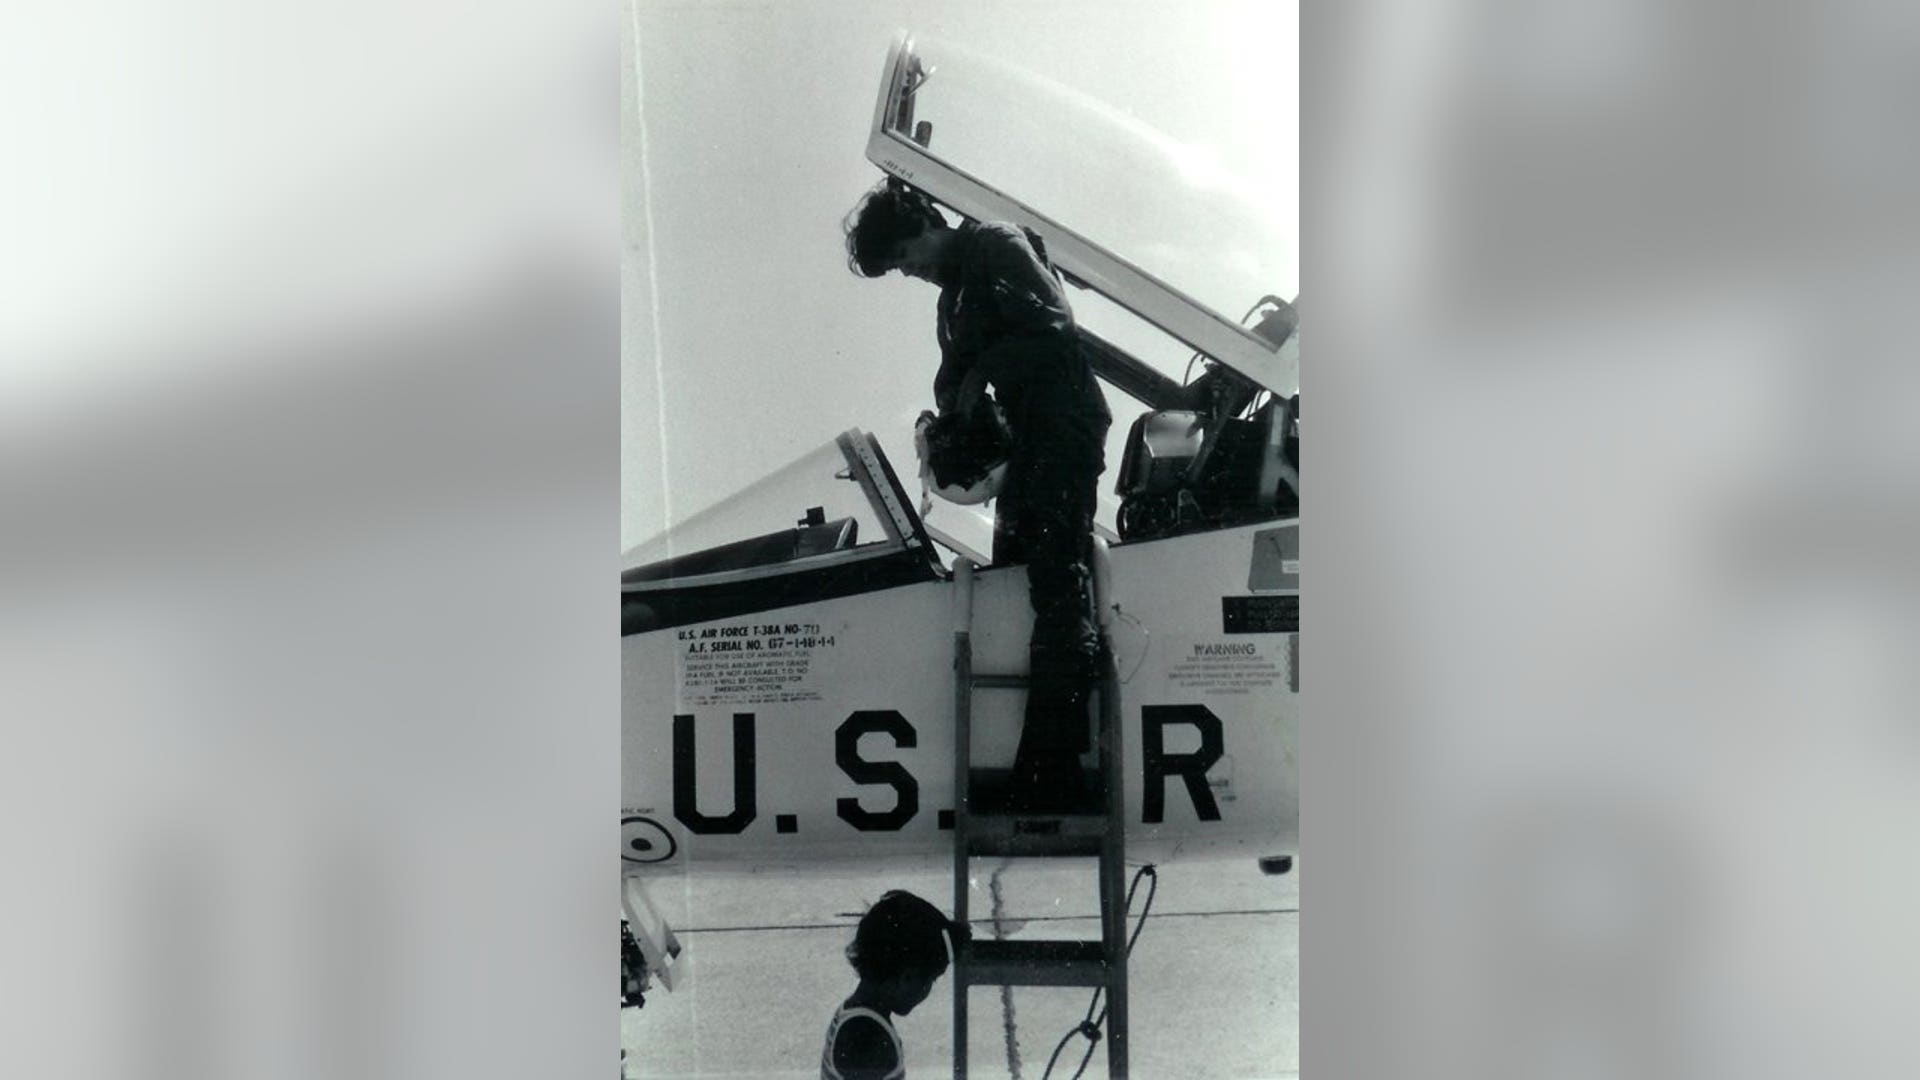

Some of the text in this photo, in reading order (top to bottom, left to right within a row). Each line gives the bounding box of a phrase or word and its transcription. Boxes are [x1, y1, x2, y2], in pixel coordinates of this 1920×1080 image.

[678, 629, 697, 641] U.S.
[701, 628, 718, 638] AIR
[720, 626, 749, 637] FORCE
[689, 642, 708, 653] A.F.
[711, 641, 742, 652] SERIAL
[746, 639, 764, 650] NO.
[1194, 643, 1256, 656] WARNING
[731, 661, 763, 669] AIRCRAFT
[765, 660, 784, 668] WITH
[786, 659, 809, 667] GRADE
[748, 676, 786, 684] CONSULTED
[714, 685, 754, 693] EMERGENCY
